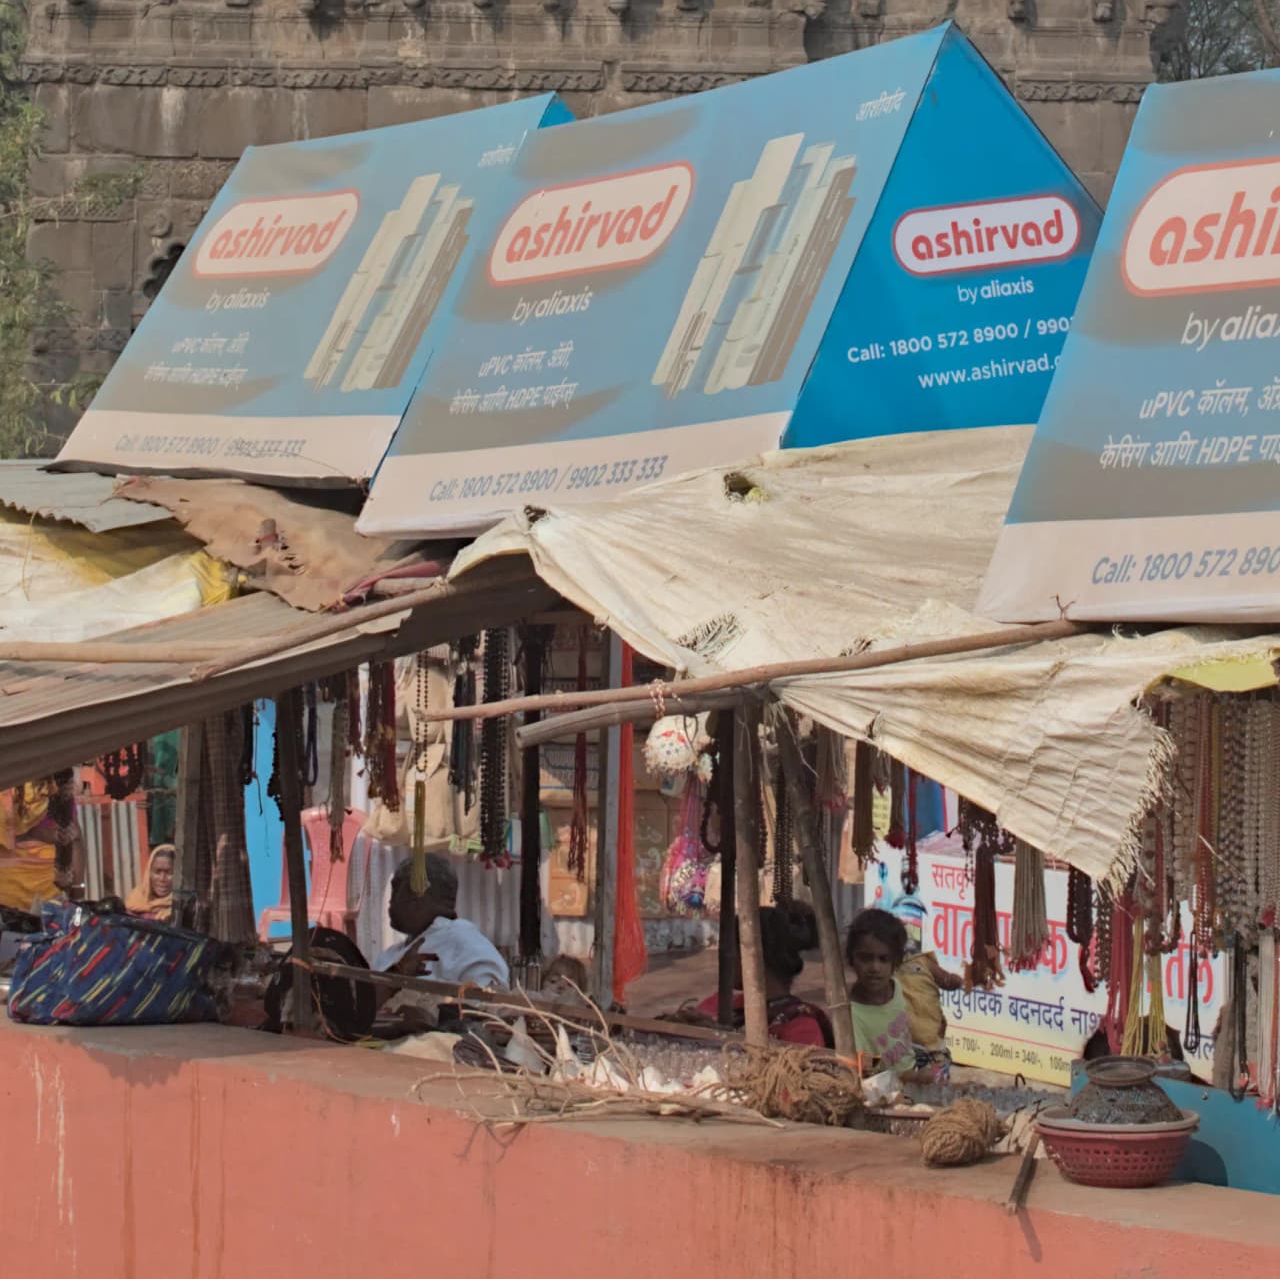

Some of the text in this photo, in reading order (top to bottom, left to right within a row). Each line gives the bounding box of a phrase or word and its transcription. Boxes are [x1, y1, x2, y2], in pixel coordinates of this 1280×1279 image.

[209, 209, 348, 259] ashirvad
[506, 185, 679, 263] ashirvad
[911, 209, 1064, 261] ashirvad
[512, 285, 593, 327] by aliaxis
[958, 276, 1035, 305] by aliaxis
[847, 343, 886, 363] Call:
[889, 337, 933, 357] 1800
[938, 330, 969, 349] 572
[974, 322, 1019, 343] 8900
[1037, 316, 1073, 335] 990
[1181, 312, 1220, 353] by
[1139, 388, 1195, 419] uPVC
[1150, 430, 1199, 466] आणि
[1196, 435, 1257, 465] HDPE
[459, 476, 494, 498] 1800
[492, 473, 520, 495] 572
[519, 468, 558, 492] 8900
[567, 463, 608, 490] 9902
[606, 460, 638, 485] 333
[636, 455, 669, 480] 333
[1092, 554, 1136, 584] Call:
[1139, 551, 1193, 581] 1800
[1193, 548, 1238, 578] 572
[1008, 996, 1065, 1031] बदनदर्द
